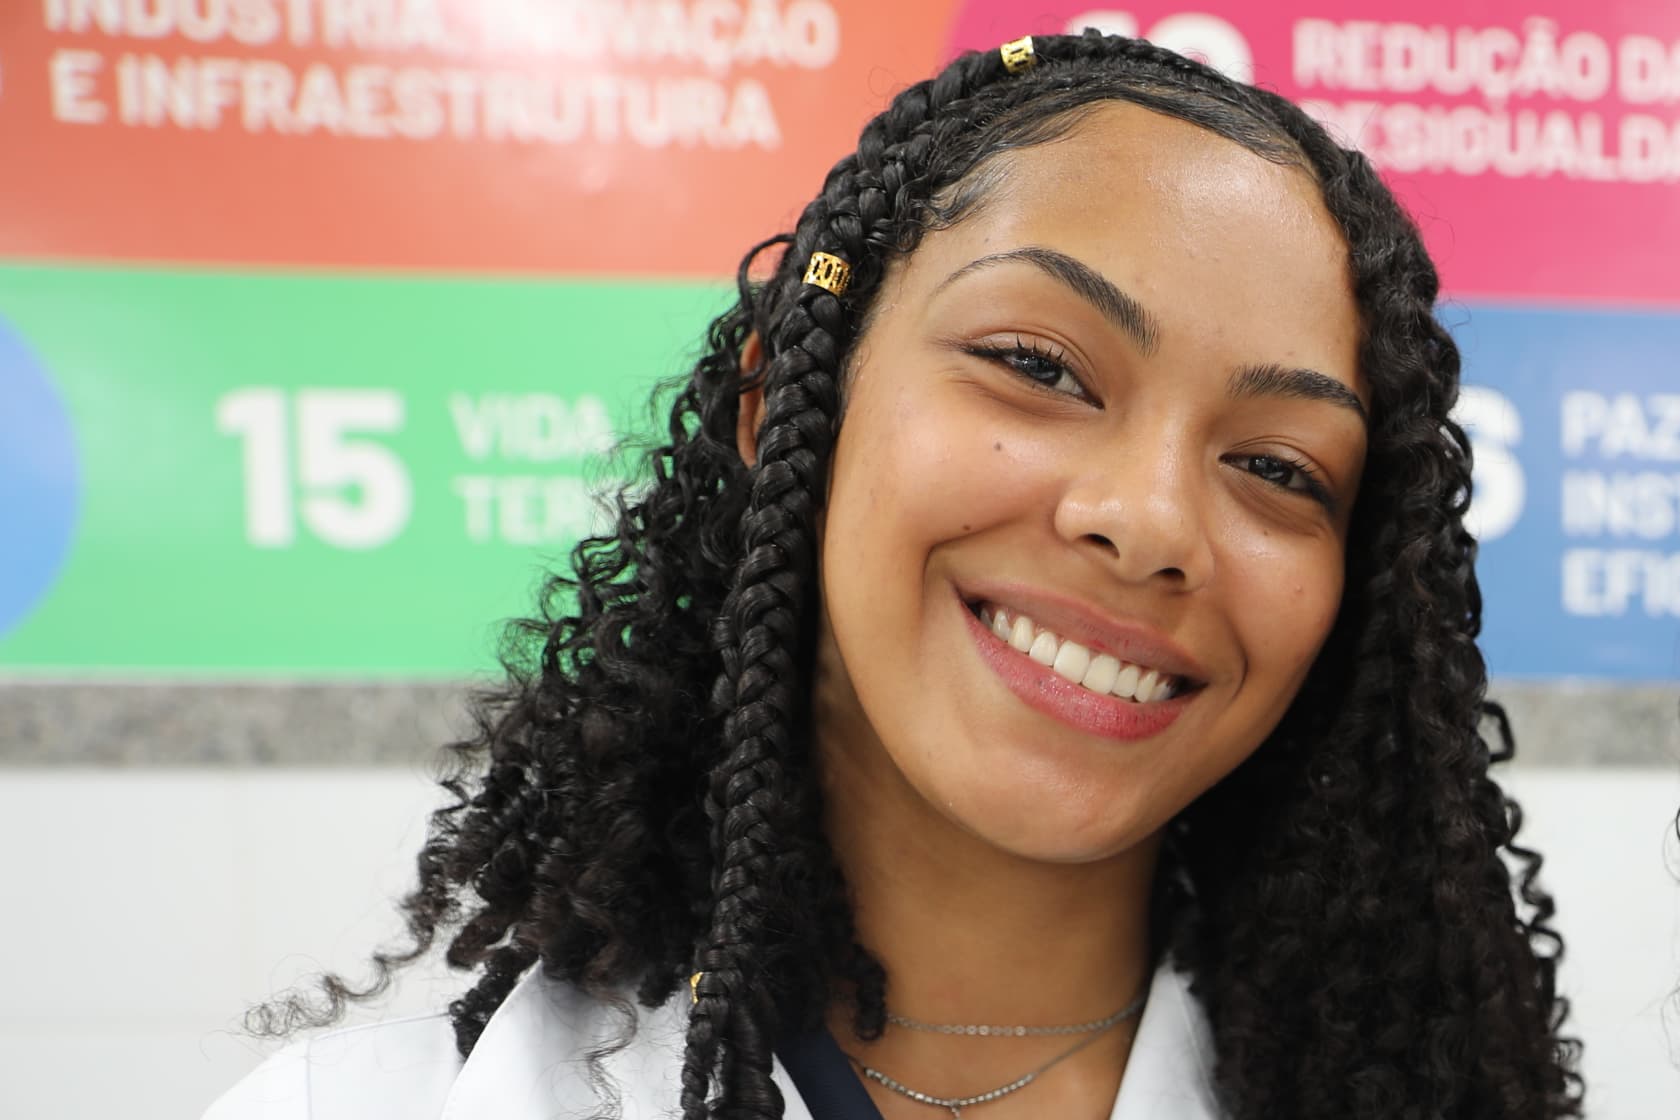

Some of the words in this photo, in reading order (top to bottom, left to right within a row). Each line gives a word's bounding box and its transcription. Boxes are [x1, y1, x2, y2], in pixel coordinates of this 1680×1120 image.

[49, 47, 106, 124] E
[115, 53, 784, 151] INFRAESTRUTURA
[1292, 16, 1611, 108] REDUÇÃO
[214, 386, 414, 549] 15
[449, 393, 617, 462] VIDA
